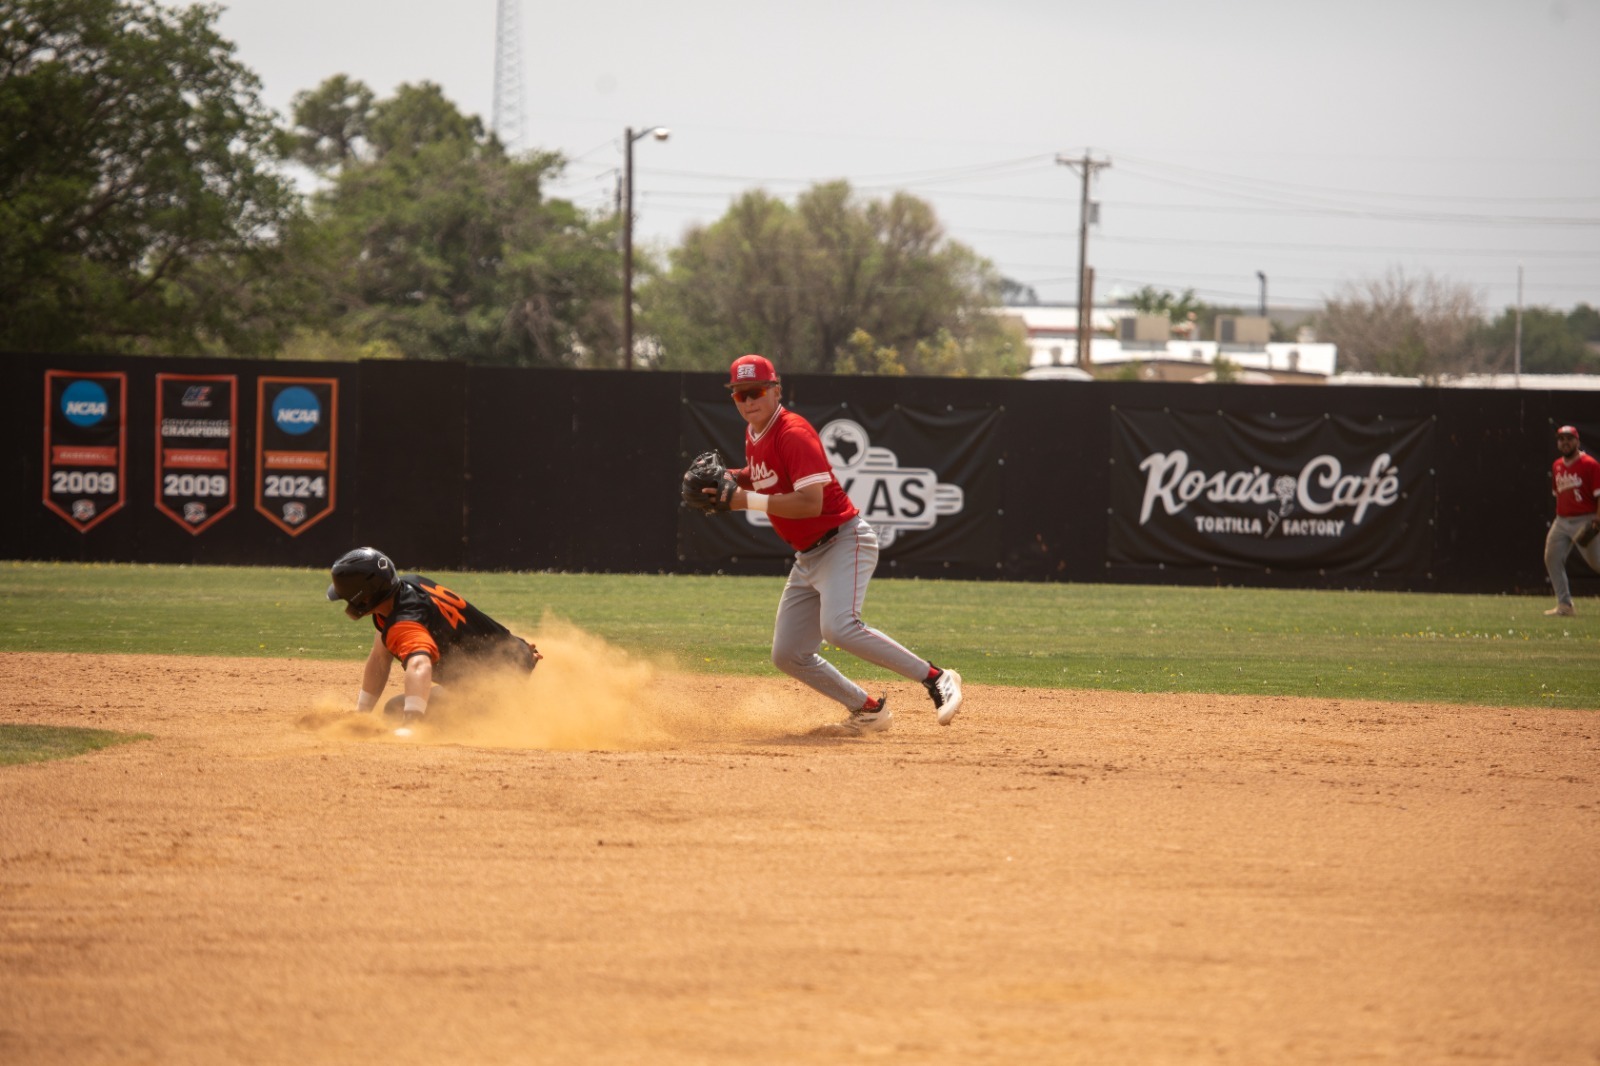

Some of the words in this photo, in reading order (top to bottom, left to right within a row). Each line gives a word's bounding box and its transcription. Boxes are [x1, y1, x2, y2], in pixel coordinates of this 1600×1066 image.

[66, 401, 107, 416] NCAA
[277, 408, 319, 424] NCAA
[161, 418, 230, 427] CONFERENCE
[161, 426, 230, 438] CHAMPIONS
[52, 471, 116, 494] 2009
[163, 474, 226, 496] 2009
[264, 475, 325, 498] 2024
[1138, 450, 1277, 526] Rosa's
[1297, 453, 1399, 526] Café
[1194, 516, 1263, 535] TORTILLA
[1281, 519, 1346, 537] FACTORY
